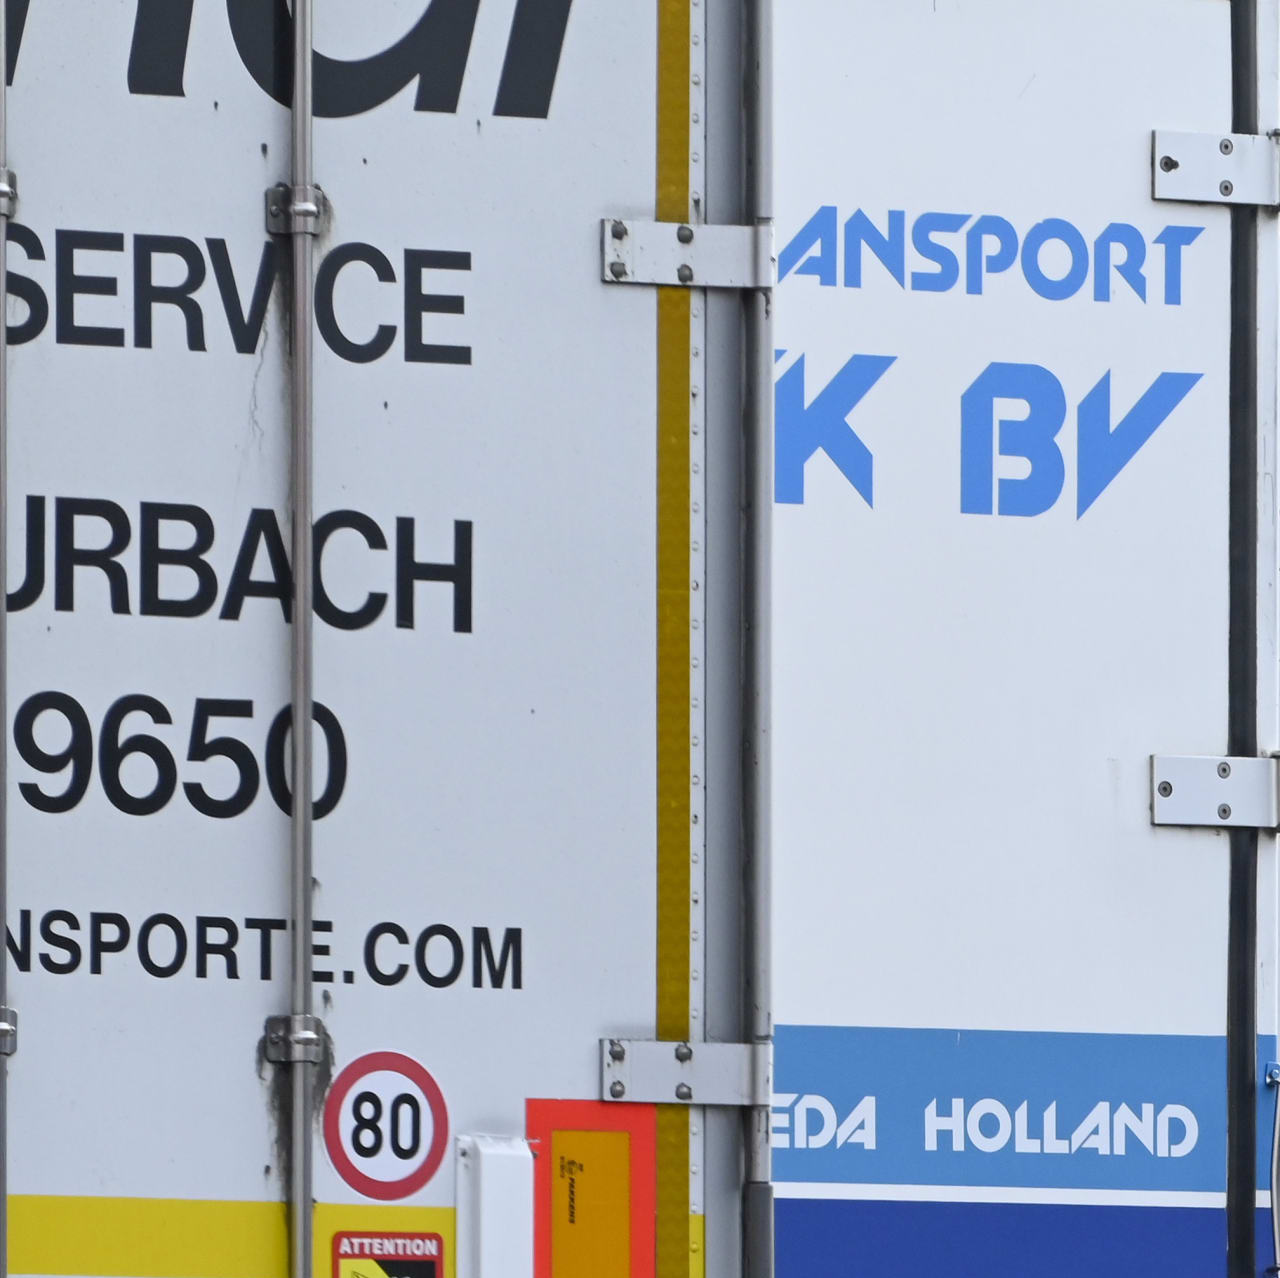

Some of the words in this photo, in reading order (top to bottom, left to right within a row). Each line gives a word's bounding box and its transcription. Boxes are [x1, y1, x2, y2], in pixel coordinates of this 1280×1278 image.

[5, 221, 472, 366] SERVCE
[777, 205, 1206, 306] ANSPORT
[774, 349, 898, 510] K
[960, 361, 1205, 521] BV
[13, 690, 348, 821] 9650
[350, 1090, 422, 1160] 80
[924, 1097, 1199, 1158] HOLLAND
[338, 1237, 438, 1256] ATTENTION
